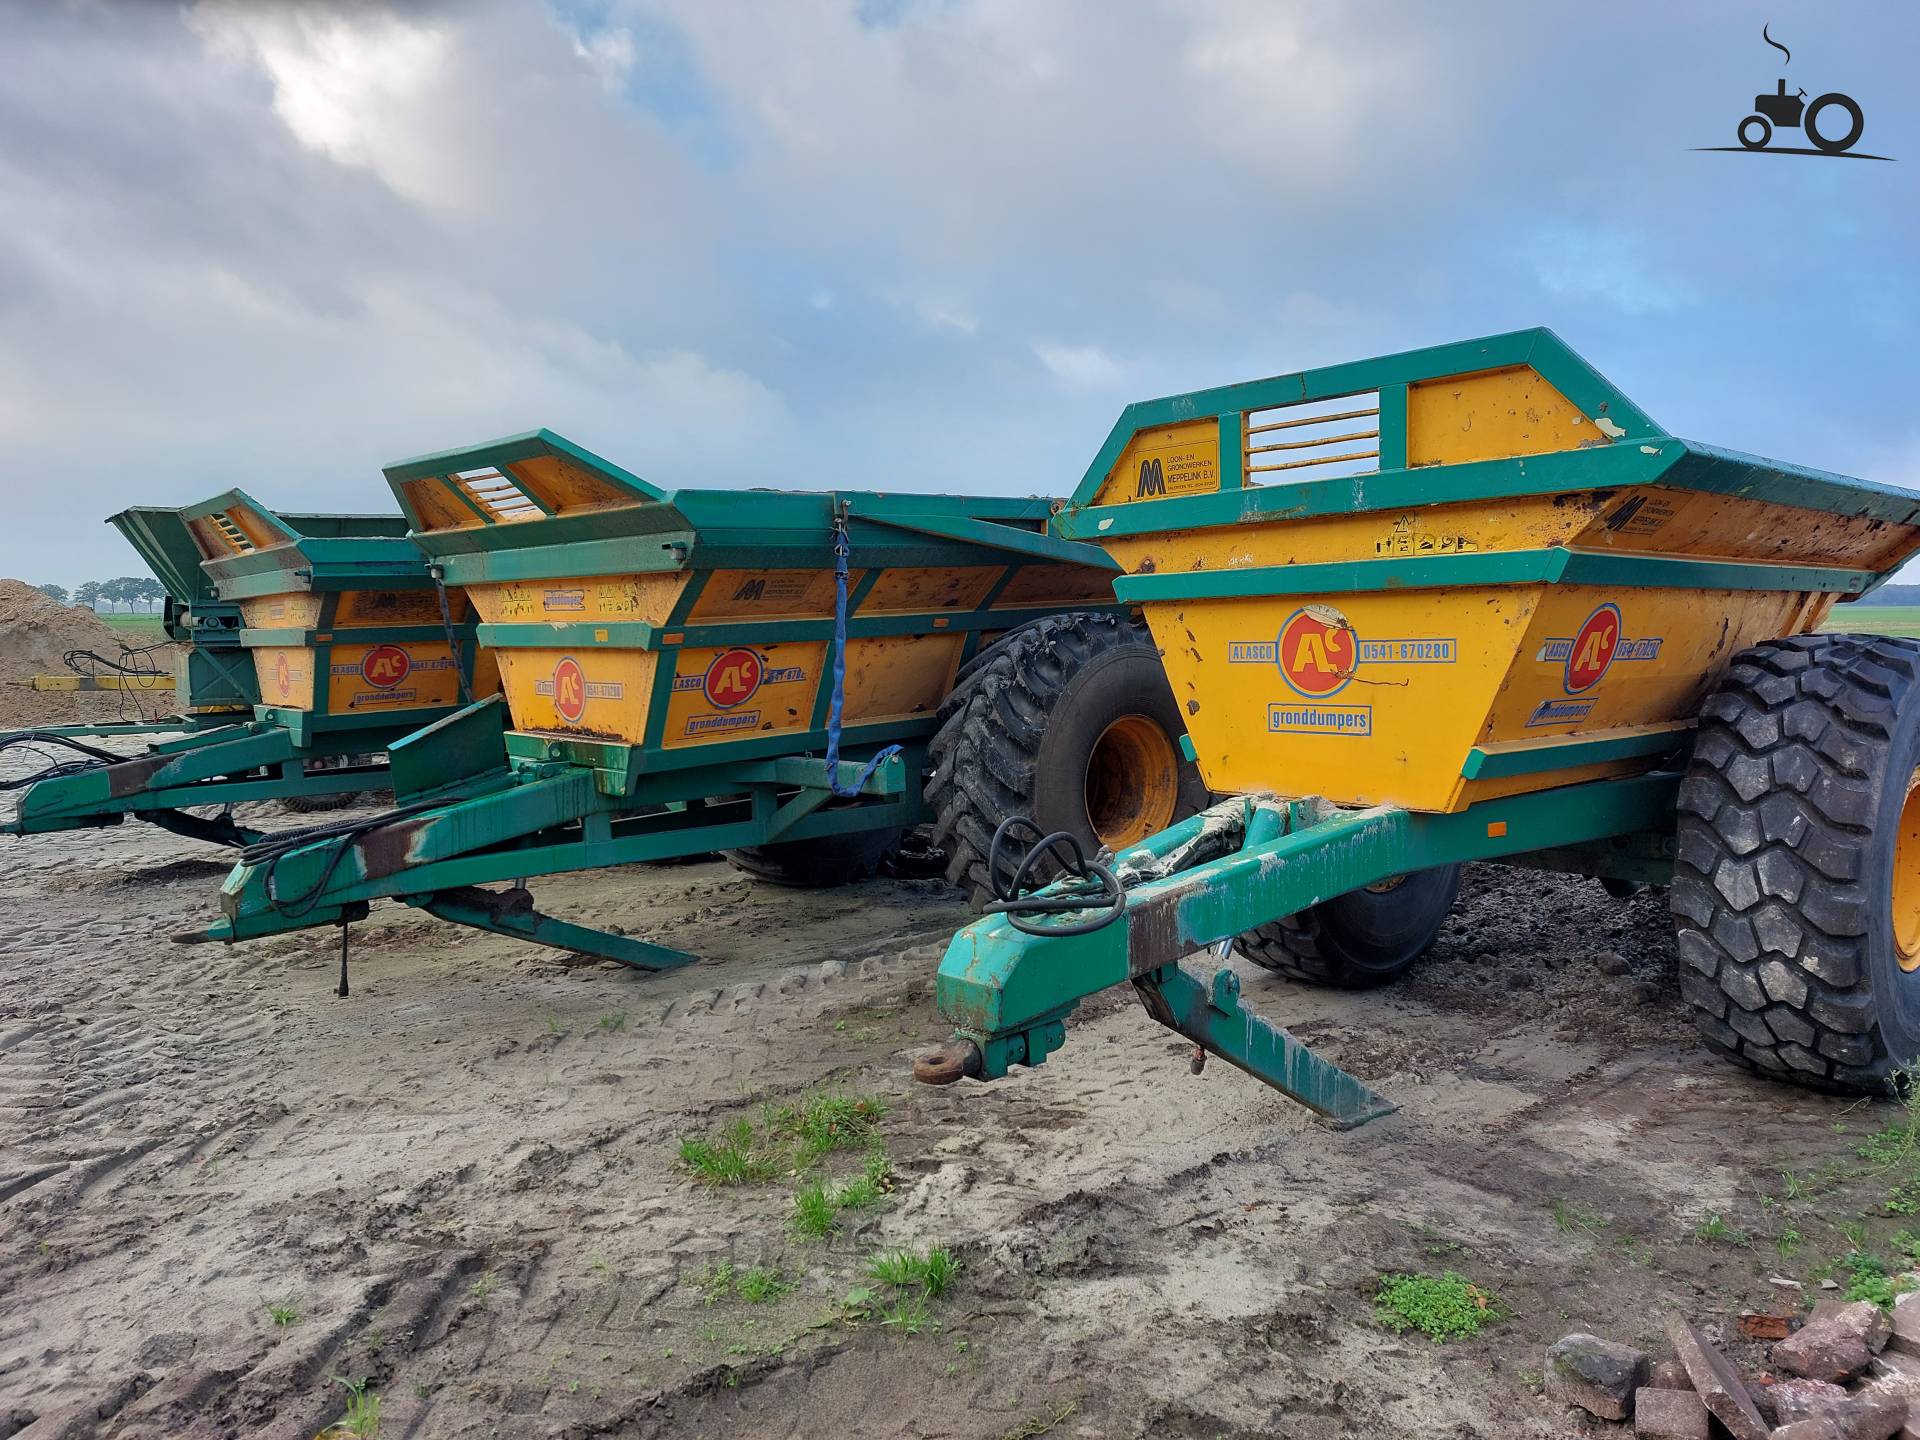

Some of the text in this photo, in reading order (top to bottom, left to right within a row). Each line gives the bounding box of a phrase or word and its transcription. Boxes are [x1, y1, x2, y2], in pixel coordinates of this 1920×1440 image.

[1167, 453, 1195, 464] LOON- EN
[1167, 459, 1212, 472] GRONDWERKEN
[1167, 470, 1202, 484] MEPPELINK
[1232, 645, 1272, 660] ALASCO
[1363, 643, 1449, 659] 0541-670280
[689, 714, 757, 731] gronddumpers
[1273, 708, 1367, 730] gronddumpers
